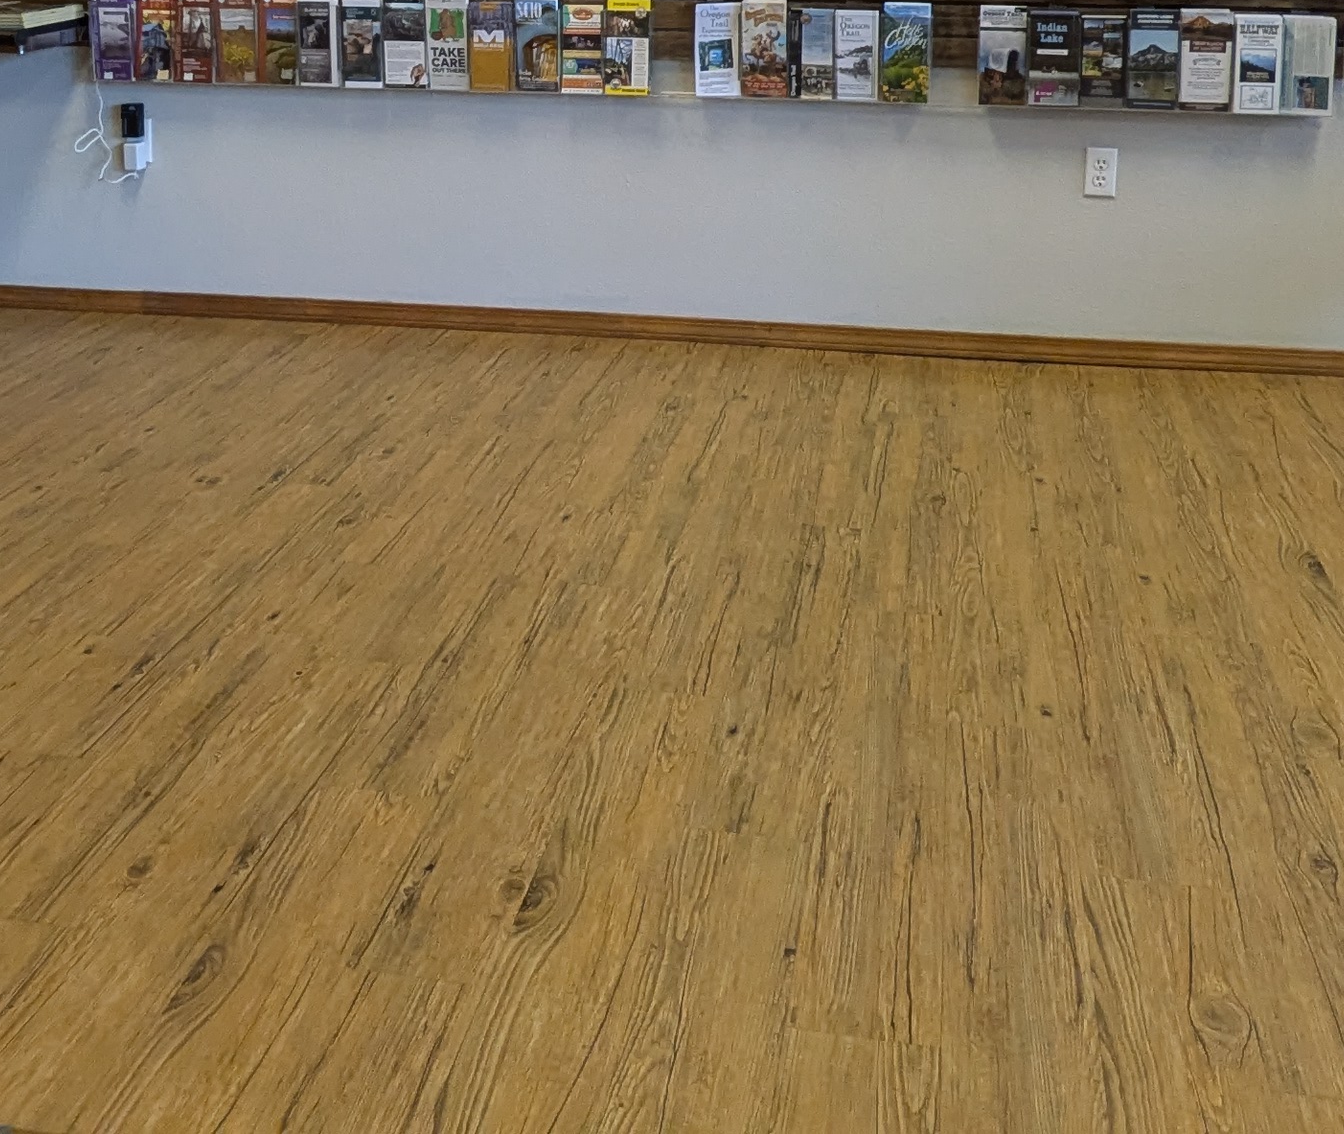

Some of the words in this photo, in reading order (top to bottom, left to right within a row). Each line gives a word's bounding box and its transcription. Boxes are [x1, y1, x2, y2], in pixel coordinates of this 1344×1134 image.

[700, 10, 730, 19] Oregon
[711, 19, 729, 27] Trail
[840, 22, 870, 30] OREGON
[1036, 23, 1068, 32] Indian
[1040, 33, 1064, 43] Lake
[430, 47, 465, 57] TAKE
[431, 58, 465, 67] CARE
